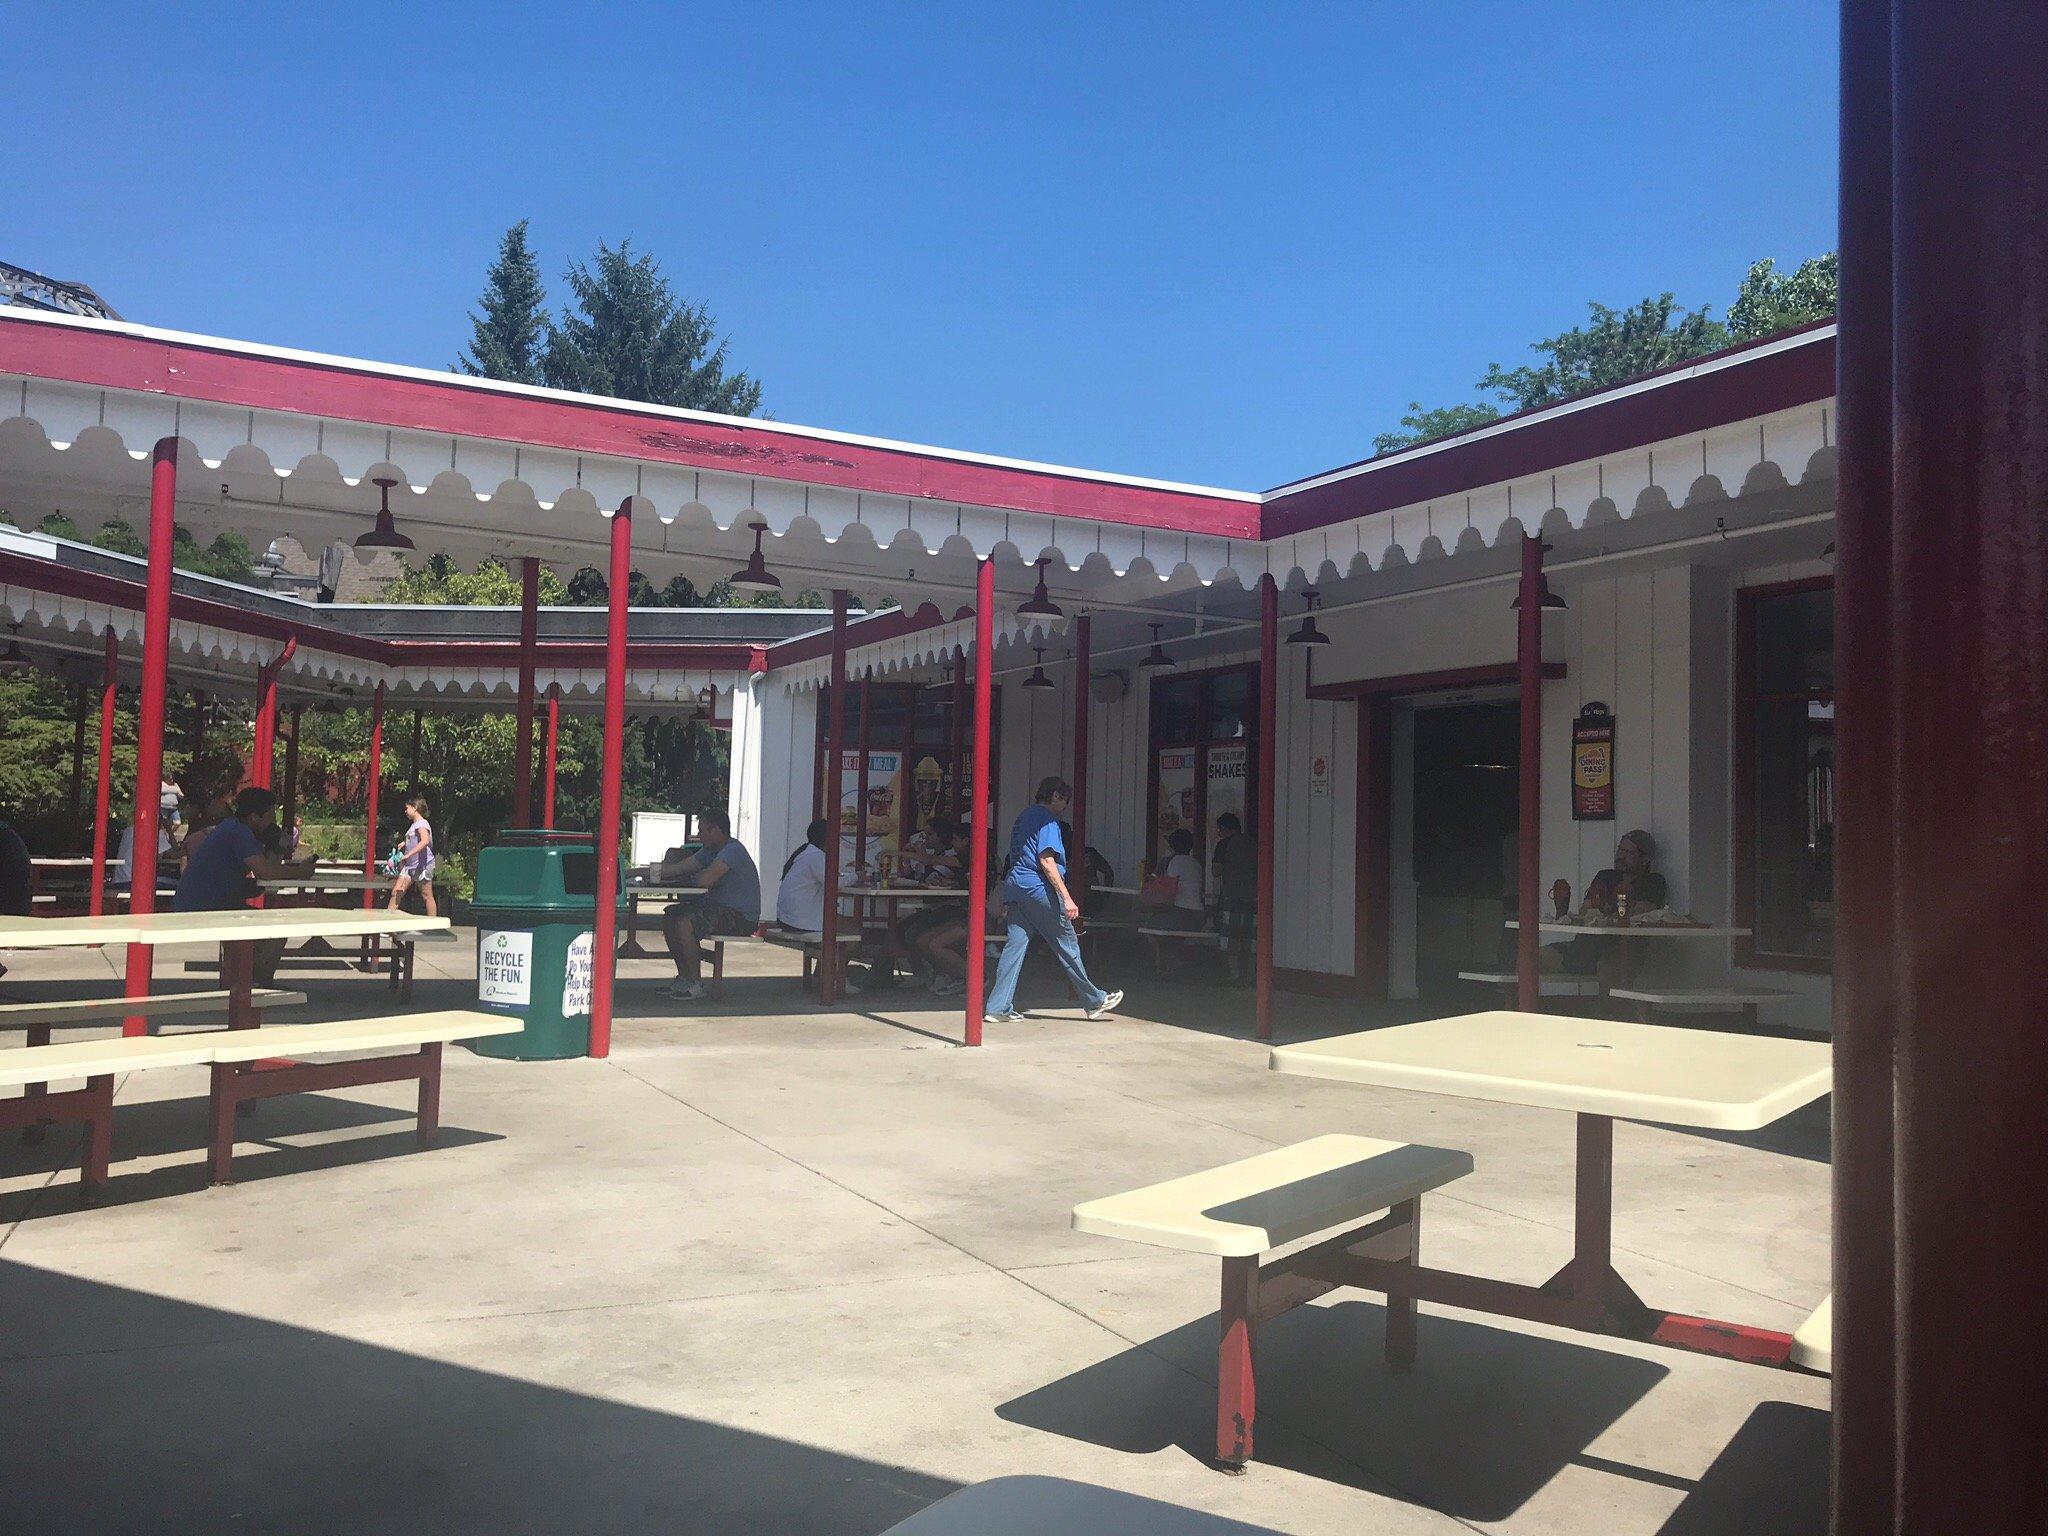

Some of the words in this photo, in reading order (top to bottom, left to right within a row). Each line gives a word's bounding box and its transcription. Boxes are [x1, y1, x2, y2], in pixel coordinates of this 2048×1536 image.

[1208, 761, 1247, 778] SHAKES
[1581, 758, 1605, 767] DINING
[1584, 766, 1603, 774] PASS
[571, 943, 587, 956] Have
[485, 951, 524, 968] RECYCLE
[484, 966, 499, 982] THE
[501, 969, 523, 984] FUN.
[567, 976, 580, 992] Help
[569, 993, 585, 1006] Park
